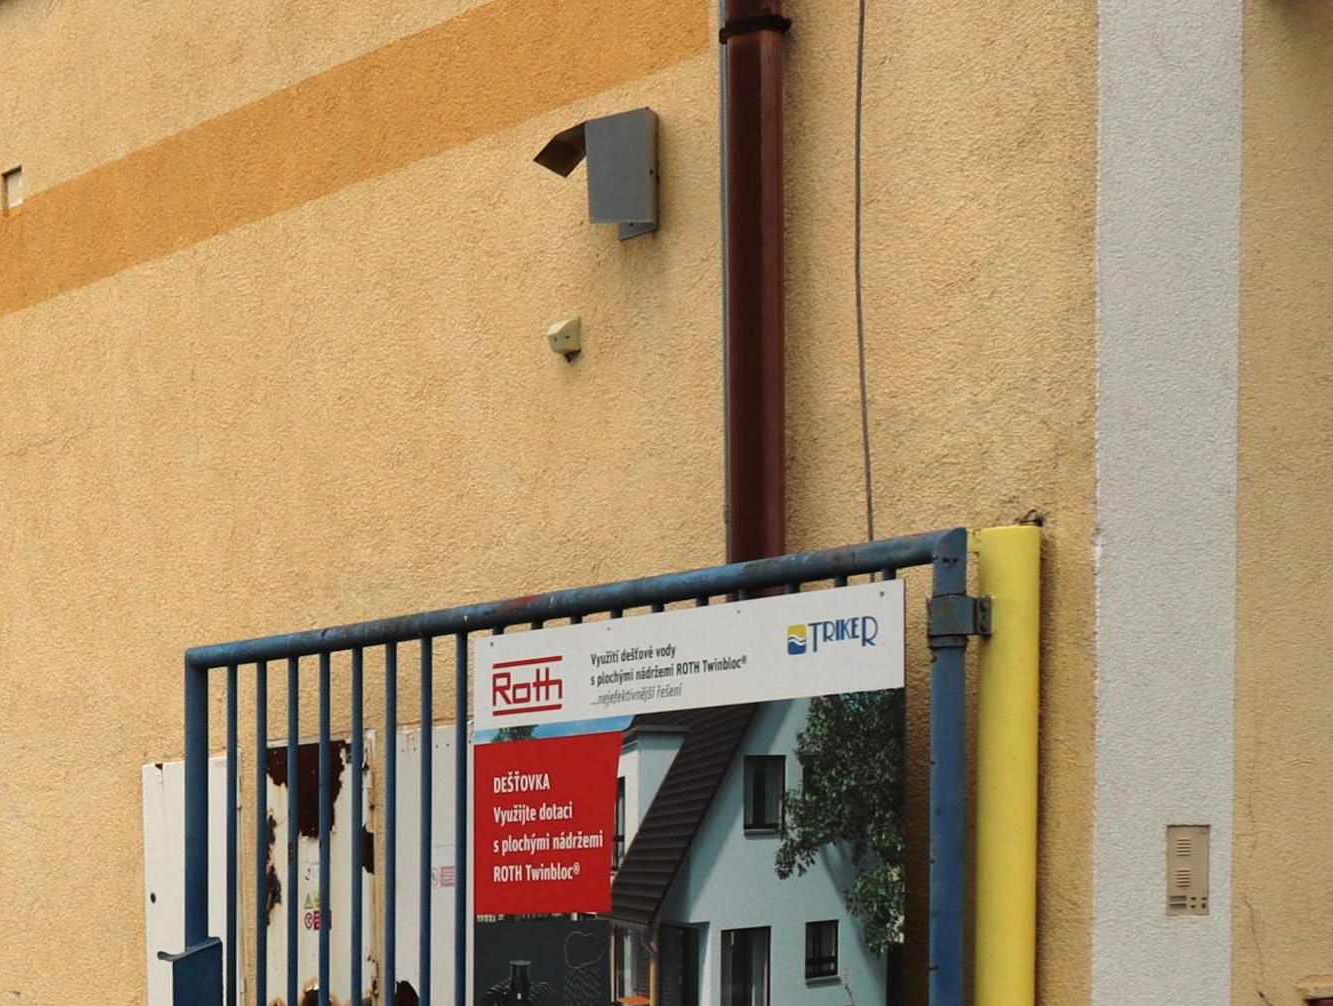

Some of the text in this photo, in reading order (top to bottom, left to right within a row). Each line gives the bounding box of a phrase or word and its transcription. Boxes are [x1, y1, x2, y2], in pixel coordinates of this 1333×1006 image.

[808, 616, 878, 652] TRIKER
[590, 643, 677, 668] Využití dešťové vody
[492, 667, 563, 707] Roth
[590, 675, 595, 686] s
[597, 668, 634, 688] plochými
[636, 665, 674, 681] nádržemi
[677, 662, 700, 676] ROTH
[657, 682, 684, 698] řešení
[493, 770, 550, 794] DEŠŤOVKA
[493, 801, 573, 827] Využijte dotaci
[493, 830, 603, 857] s plochými nádržemi
[493, 865, 523, 882] ROTH
